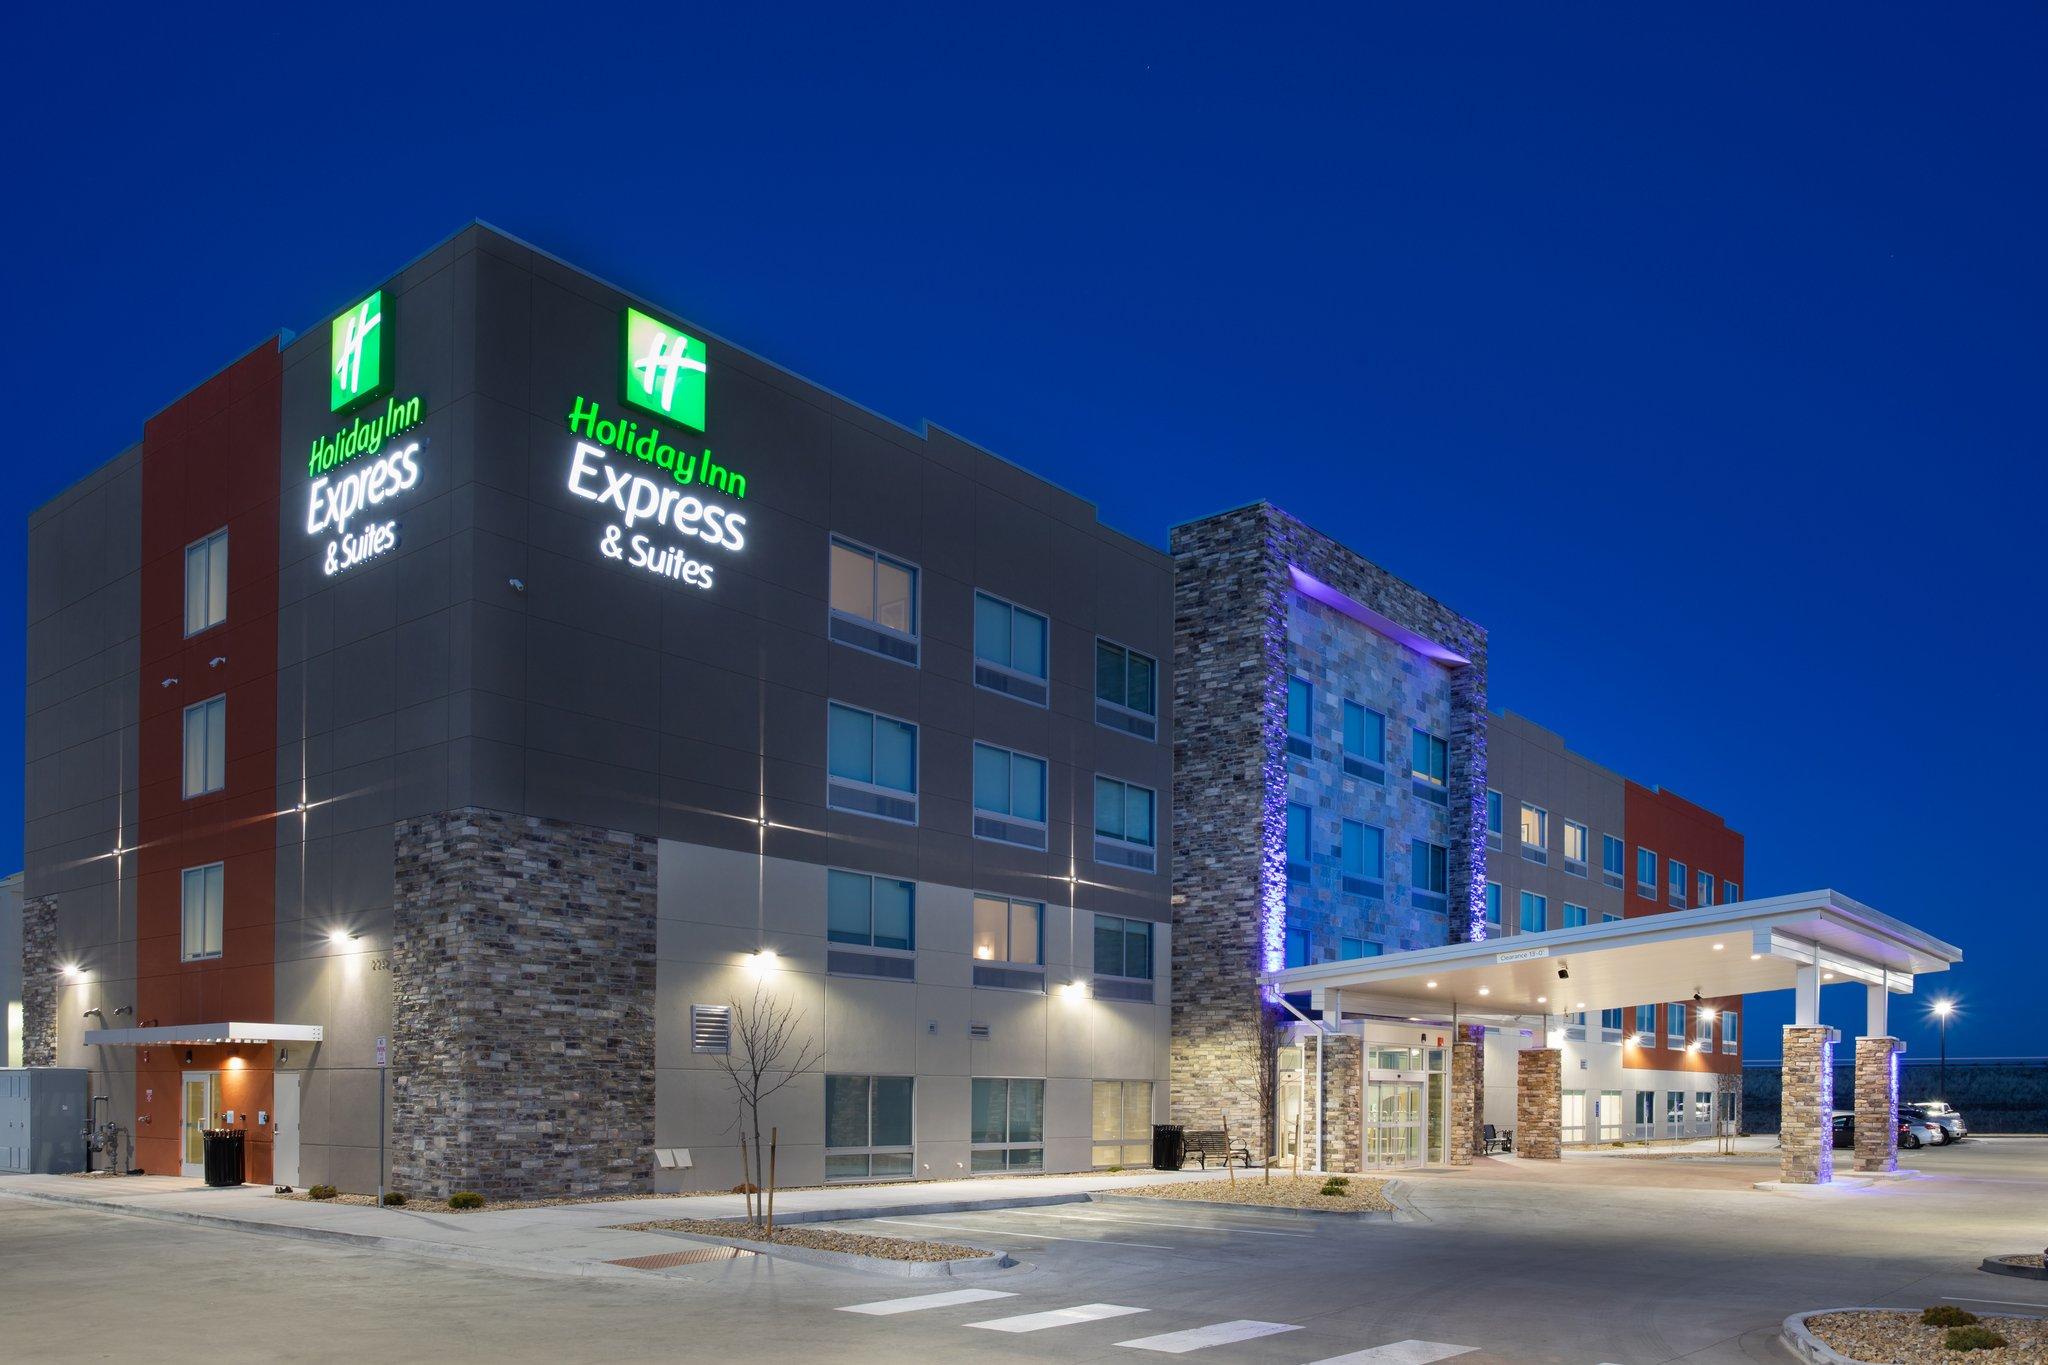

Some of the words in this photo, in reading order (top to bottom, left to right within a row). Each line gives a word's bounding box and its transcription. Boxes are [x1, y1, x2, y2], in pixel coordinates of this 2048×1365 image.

[309, 417, 384, 477] Holiday
[386, 397, 420, 437] Inn
[569, 396, 697, 485] Holiday
[700, 449, 747, 499] Inn
[307, 443, 419, 535] Express
[568, 441, 747, 551] Express
[324, 541, 339, 576] &
[341, 521, 396, 569] Suites
[600, 525, 623, 560] &
[628, 535, 714, 589] Suites
